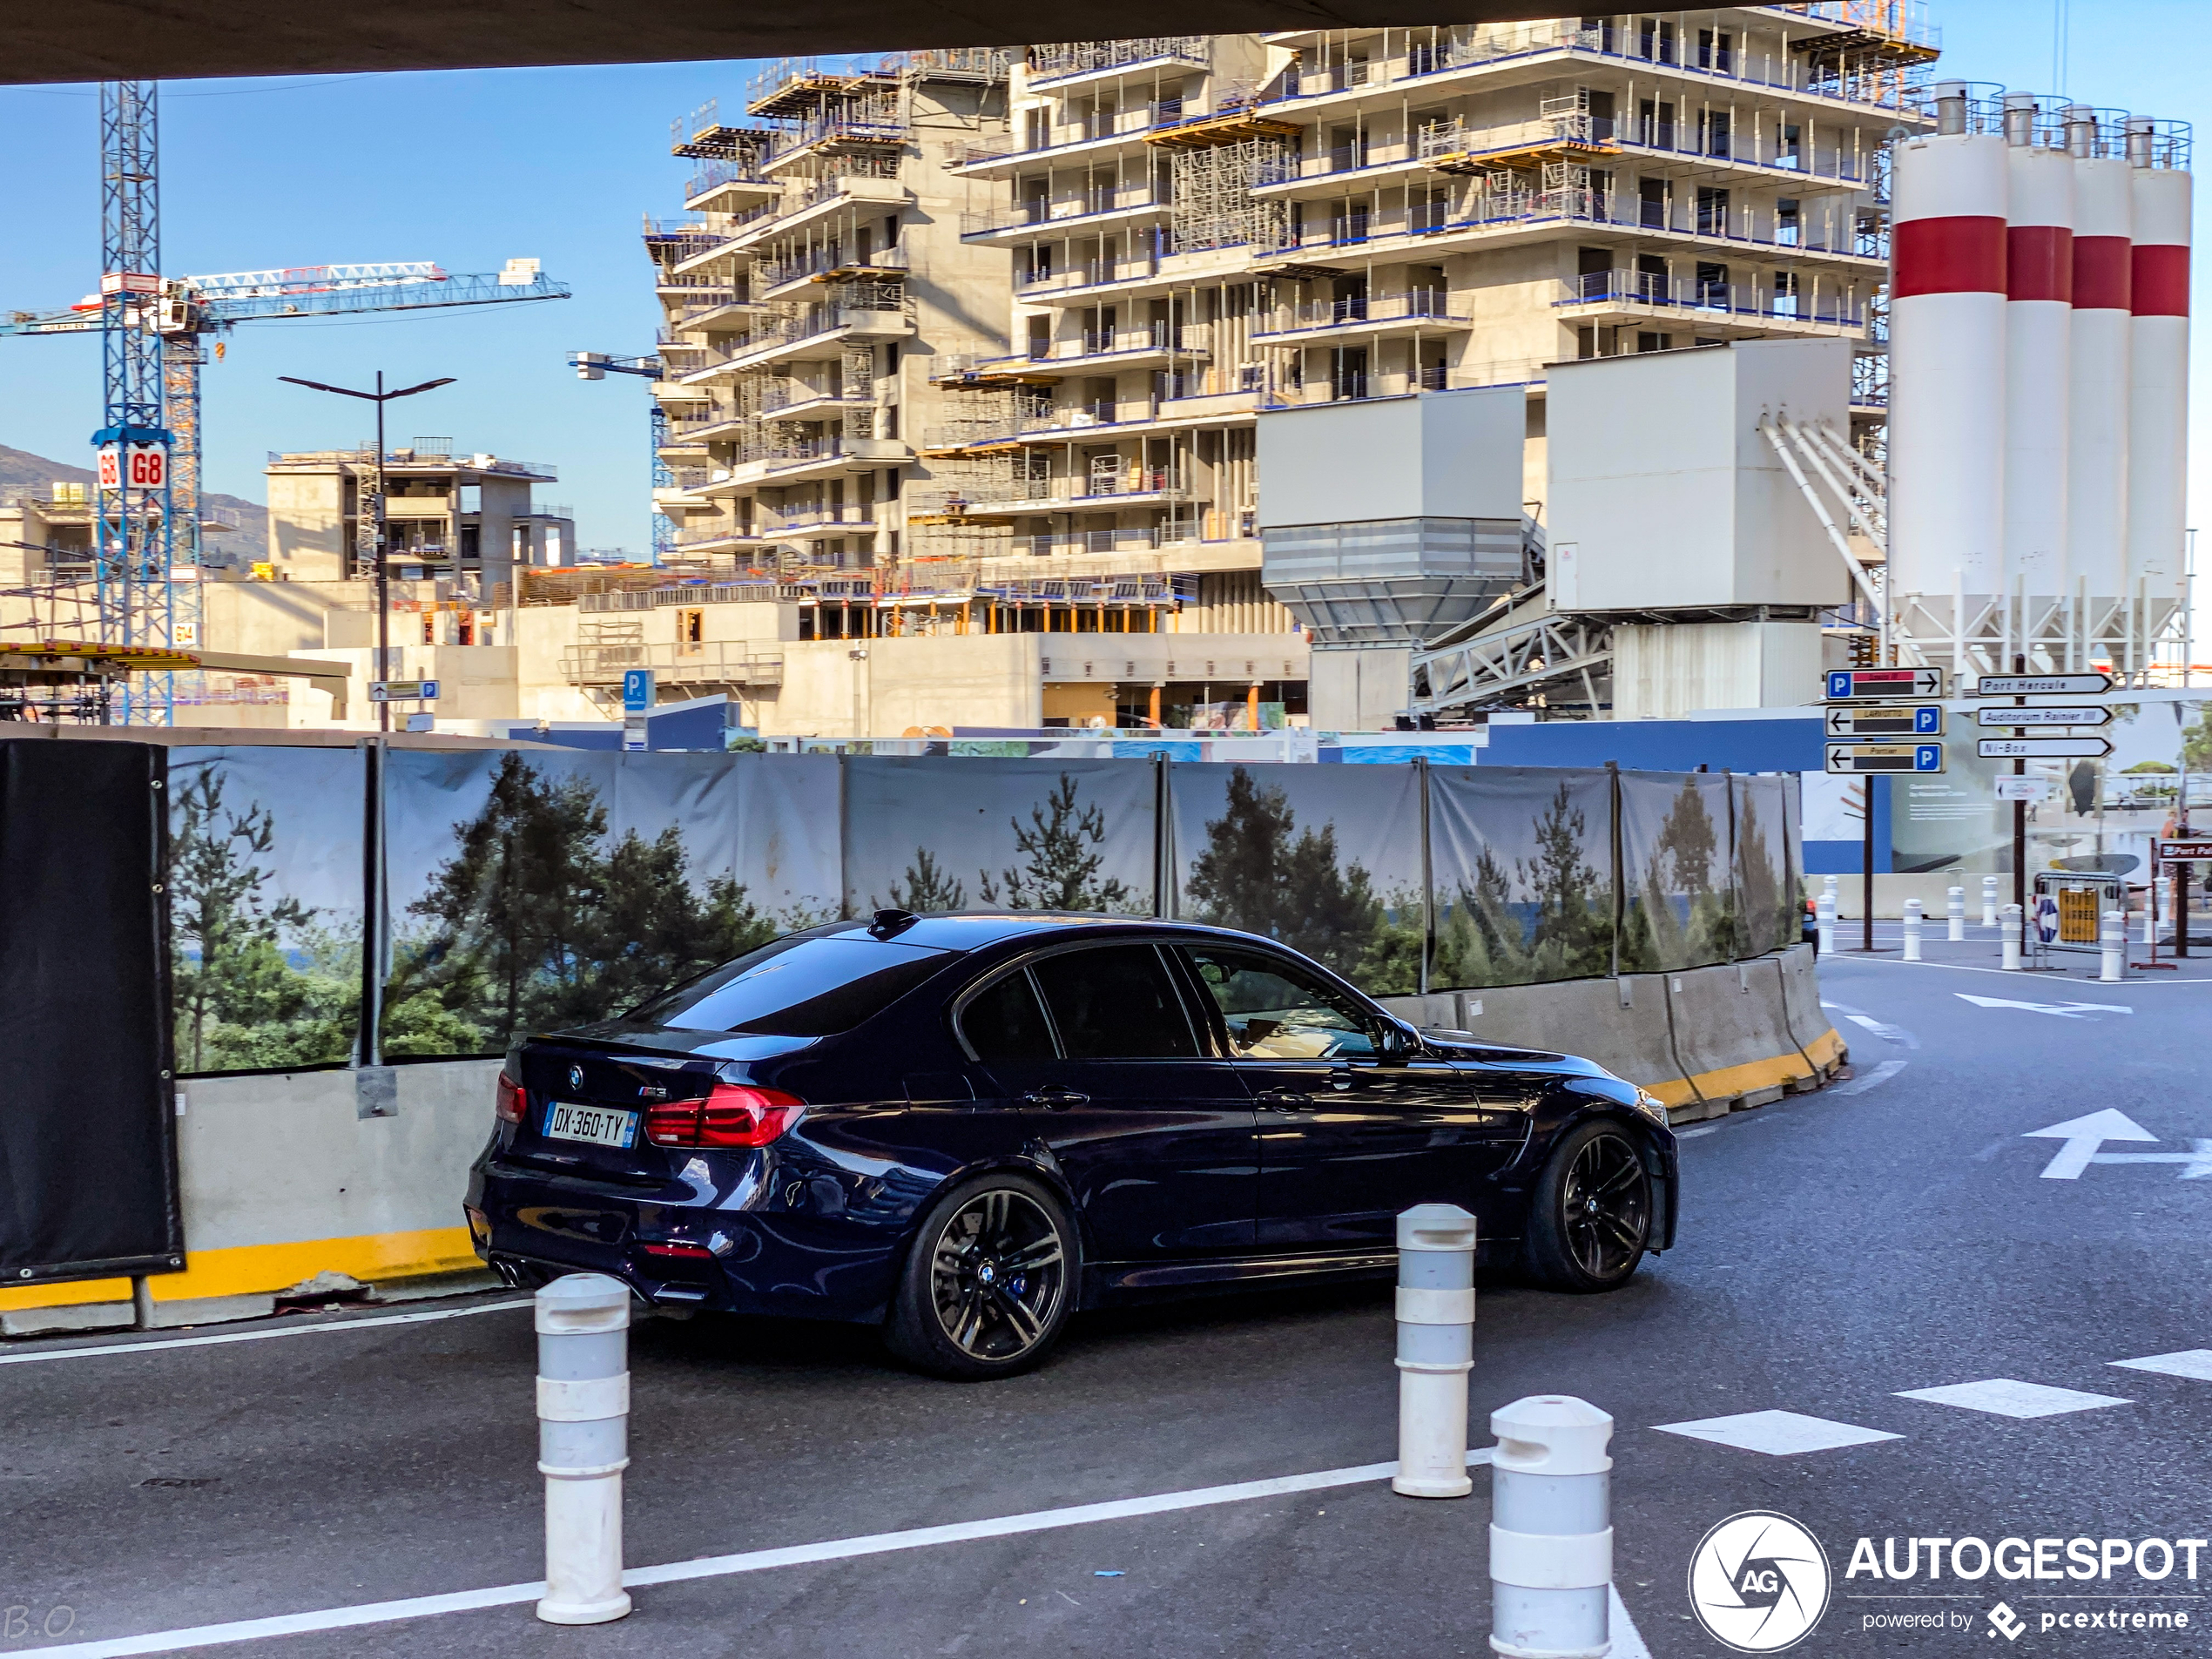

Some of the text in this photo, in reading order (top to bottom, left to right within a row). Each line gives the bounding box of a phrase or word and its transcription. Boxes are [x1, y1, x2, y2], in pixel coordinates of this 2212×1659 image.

[133, 453, 162, 484] G8
[629, 675, 639, 695] P
[1834, 678, 1845, 691] P
[1984, 680, 2067, 690] Port Hercule
[1920, 713, 1932, 728] P
[1984, 711, 2040, 721] Auditorium
[1921, 751, 1933, 765] P
[554, 1108, 624, 1141] DX-360-TY
[624, 1130, 634, 1143] 06
